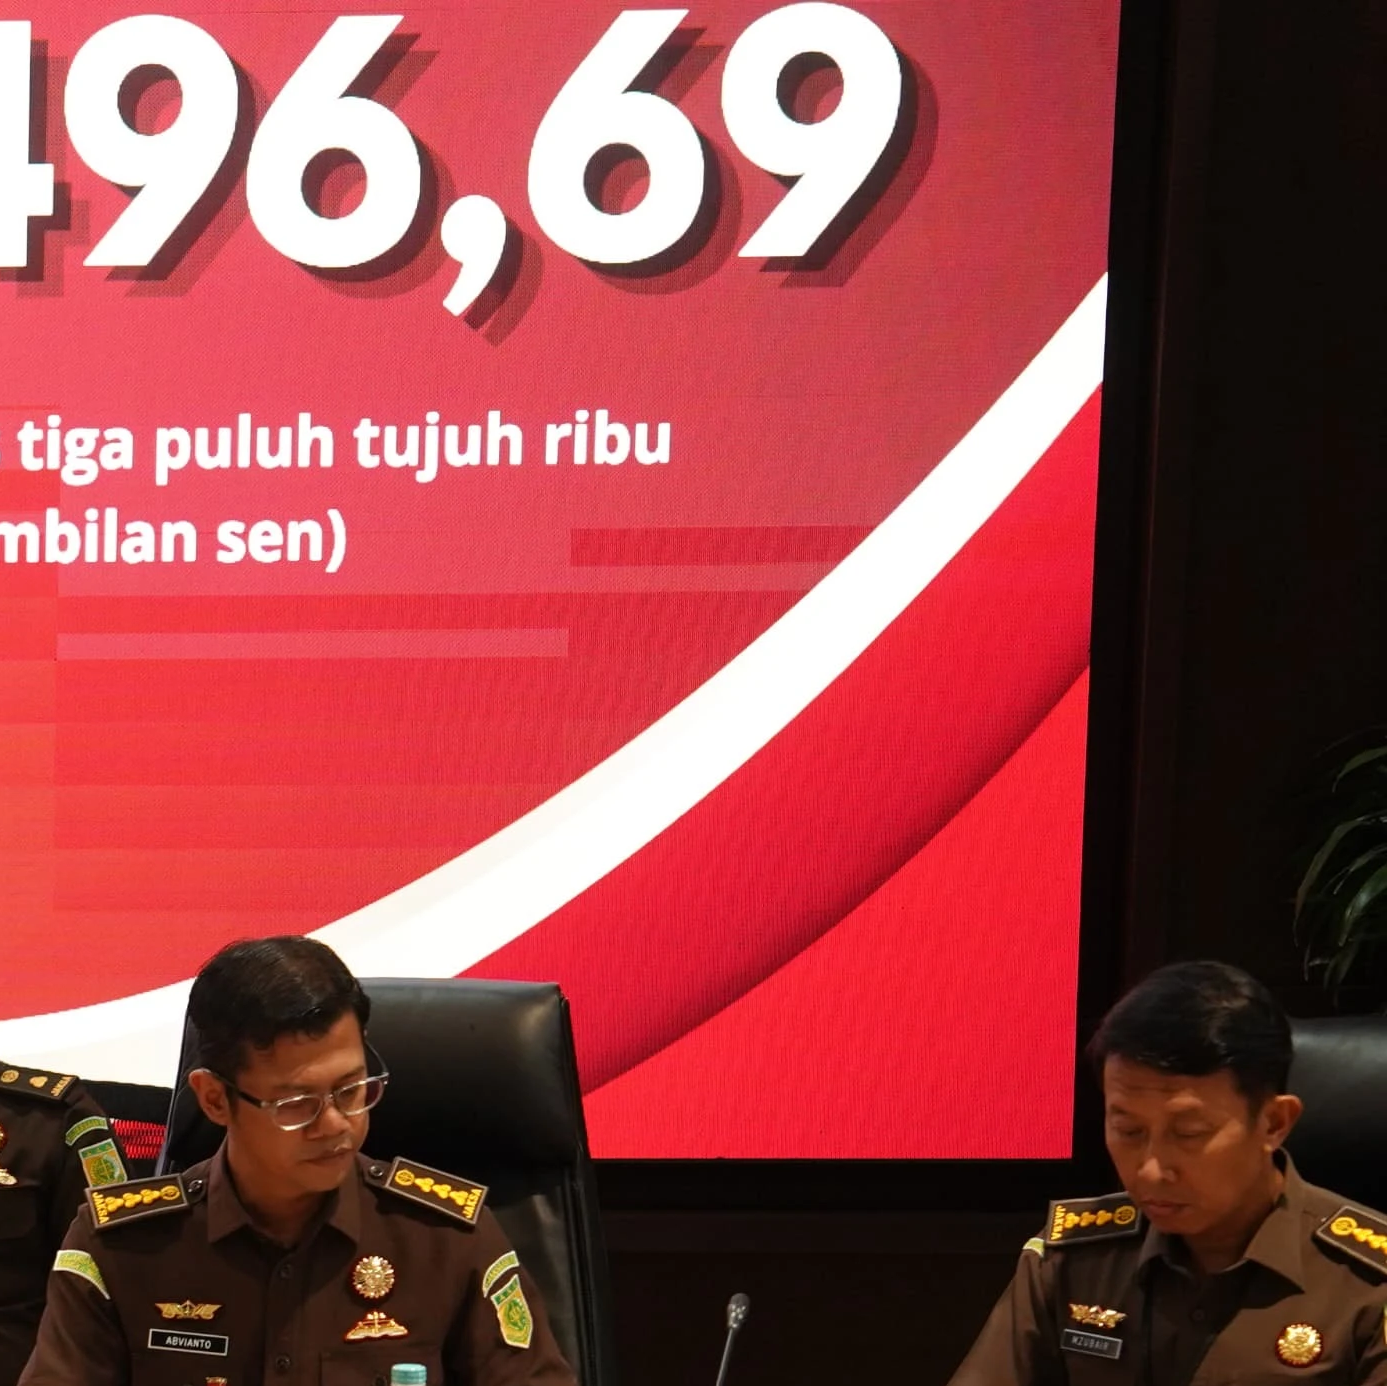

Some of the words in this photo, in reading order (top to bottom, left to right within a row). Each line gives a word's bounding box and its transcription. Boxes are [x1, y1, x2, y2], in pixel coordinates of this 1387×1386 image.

[17, 414, 134, 486] tiga
[155, 412, 334, 486] puluh
[353, 410, 523, 483] tujuh
[545, 409, 671, 466] ribu
[216, 508, 346, 573] sen)
[92, 1191, 110, 1224] JAKSA
[462, 1188, 483, 1219] JAKSA
[163, 1336, 212, 1350] ABVIANTO
